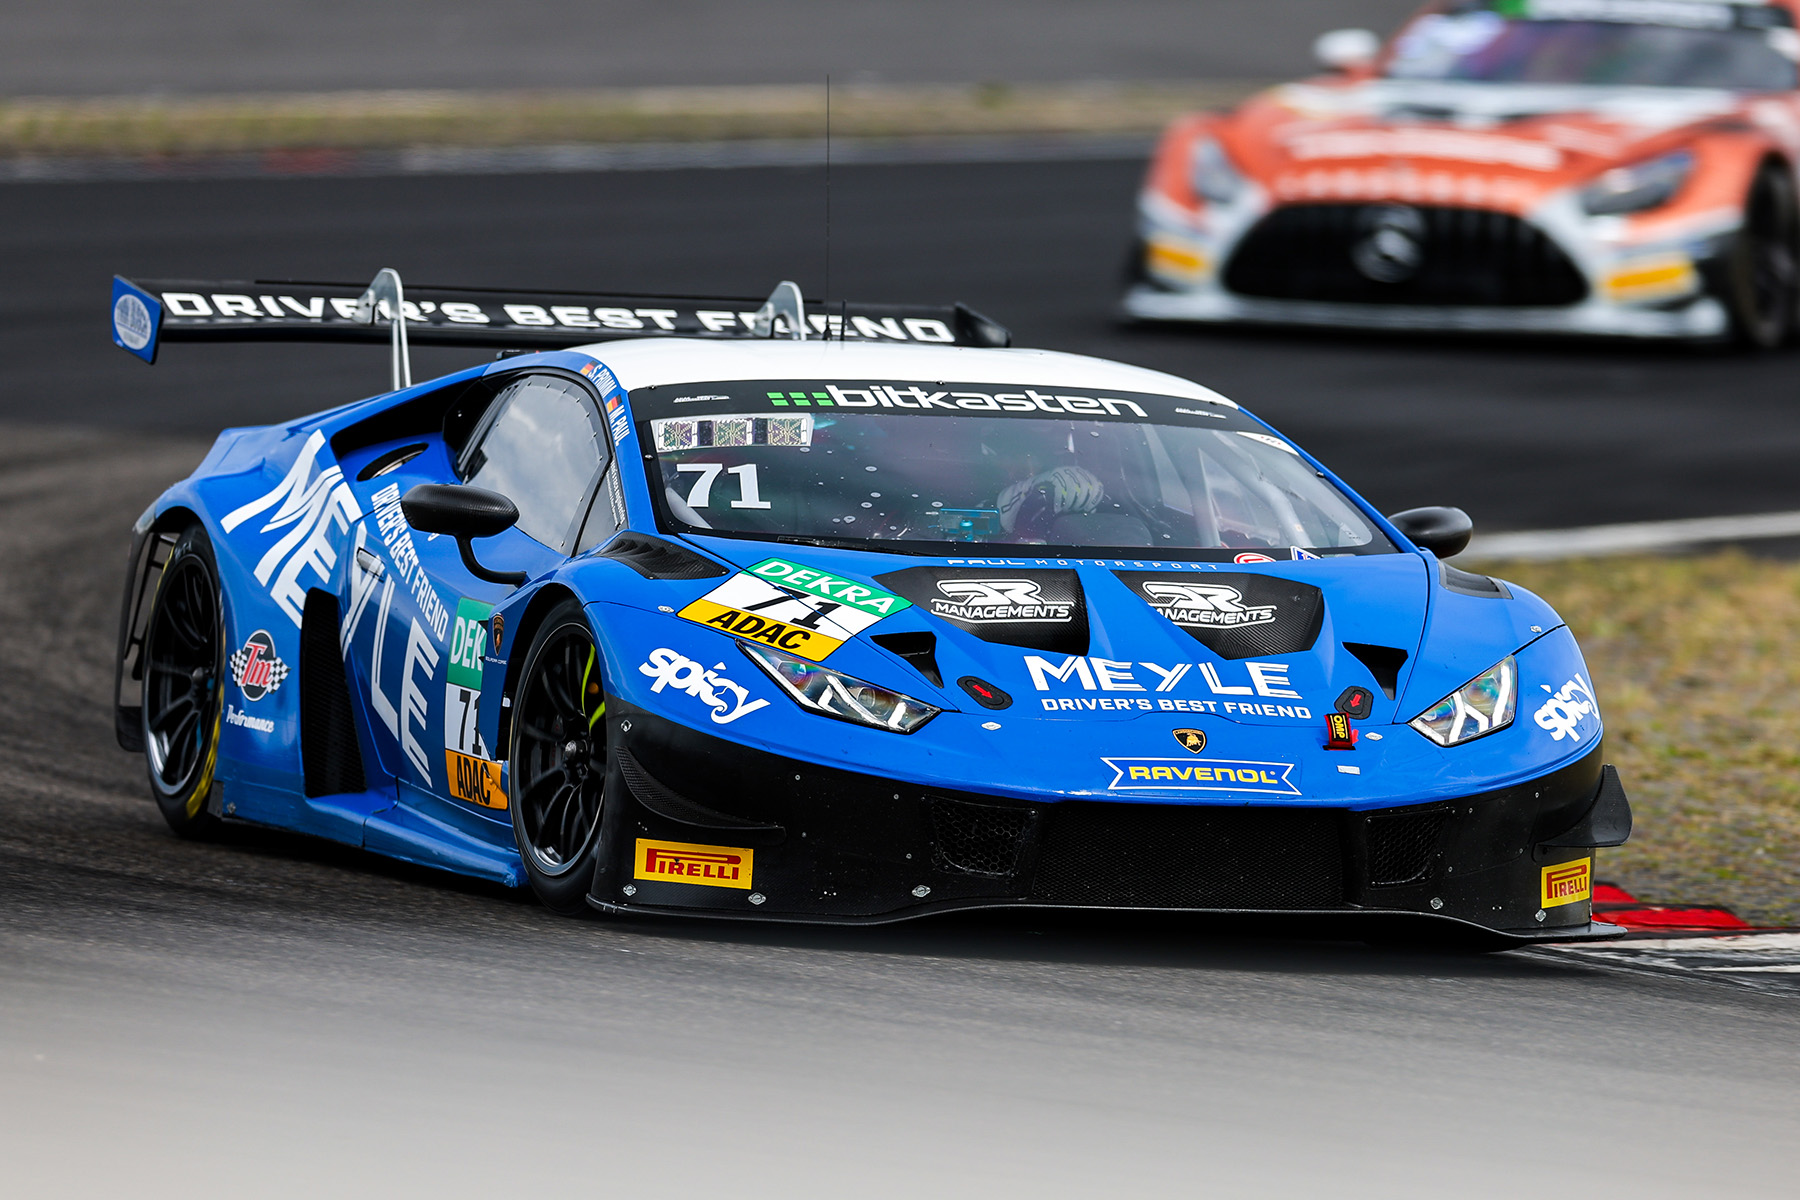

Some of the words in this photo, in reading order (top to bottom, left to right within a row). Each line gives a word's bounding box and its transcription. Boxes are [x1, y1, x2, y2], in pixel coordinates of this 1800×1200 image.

[161, 292, 490, 324] DRIVER'S
[503, 304, 678, 331] BEST
[825, 385, 1148, 417] bitkasten
[611, 415, 630, 447] PAUL
[676, 463, 771, 509] 71
[371, 482, 407, 547] DRIVER'S
[389, 531, 419, 585] BEST
[411, 566, 449, 643] FRIEND
[947, 559, 1025, 567] PAUL
[1035, 559, 1218, 571] MOTORSPORT
[754, 561, 895, 614] DEKRA
[221, 429, 440, 788] MEYLE
[743, 586, 842, 630] 71
[935, 602, 1070, 619] MANAGEMENTS
[1157, 607, 1272, 624] ANAGEMENTS
[707, 610, 811, 650] ADAC
[639, 648, 770, 724] spicy
[1024, 656, 1302, 699] MEYLE
[1041, 698, 1152, 711] DRIVER'S
[1157, 700, 1217, 713] BEST
[1223, 702, 1311, 719] FRIEND
[1334, 714, 1345, 738] OMP
[1534, 673, 1600, 742] spicy
[457, 755, 490, 806] ADAC
[1128, 766, 1278, 784] RAVENOL
[645, 848, 742, 881] PIRELLI
[1546, 863, 1588, 899] PIRELLI
